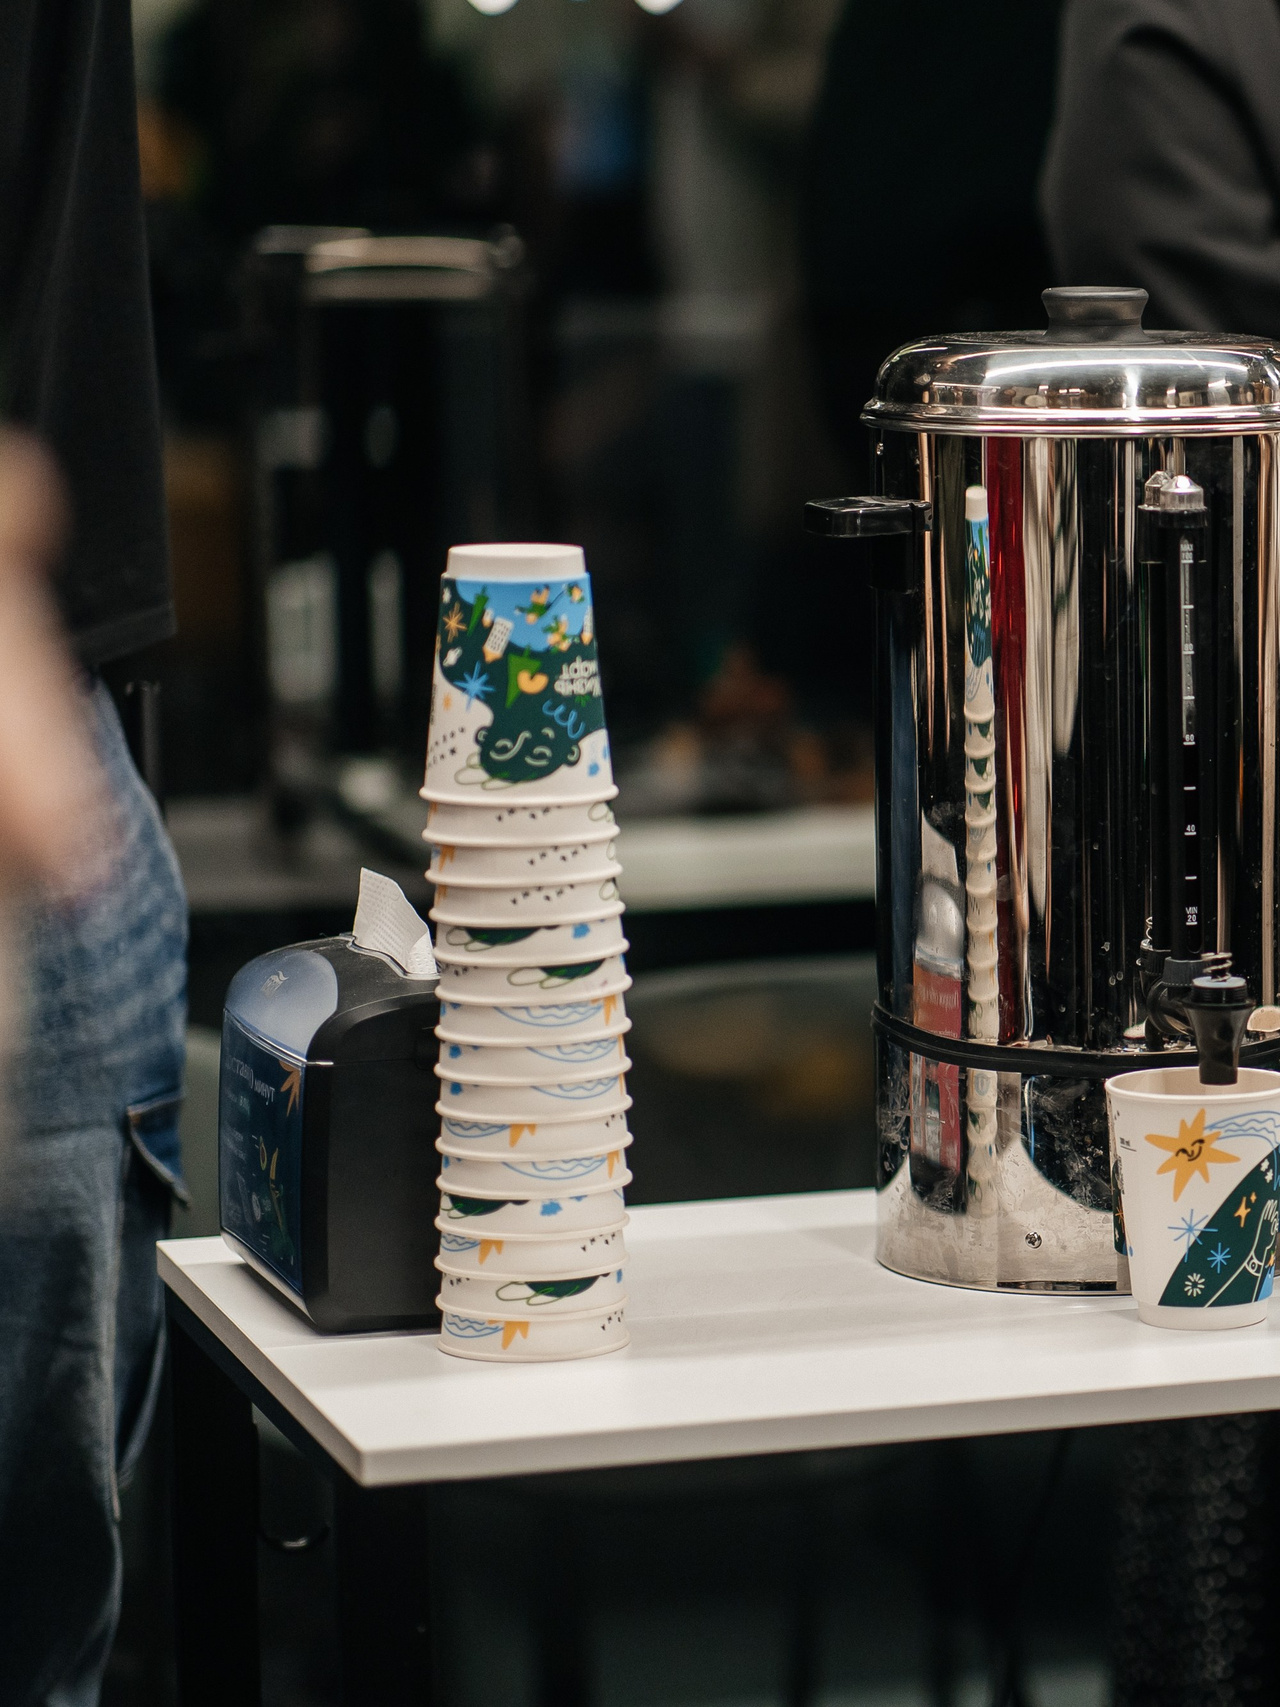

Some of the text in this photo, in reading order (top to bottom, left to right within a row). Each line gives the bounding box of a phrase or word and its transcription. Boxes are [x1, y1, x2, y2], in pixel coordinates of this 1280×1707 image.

[1185, 734, 1195, 742] 60
[1186, 824, 1196, 832] 40
[1185, 906, 1198, 914] MIN
[1187, 914, 1197, 922] 20
